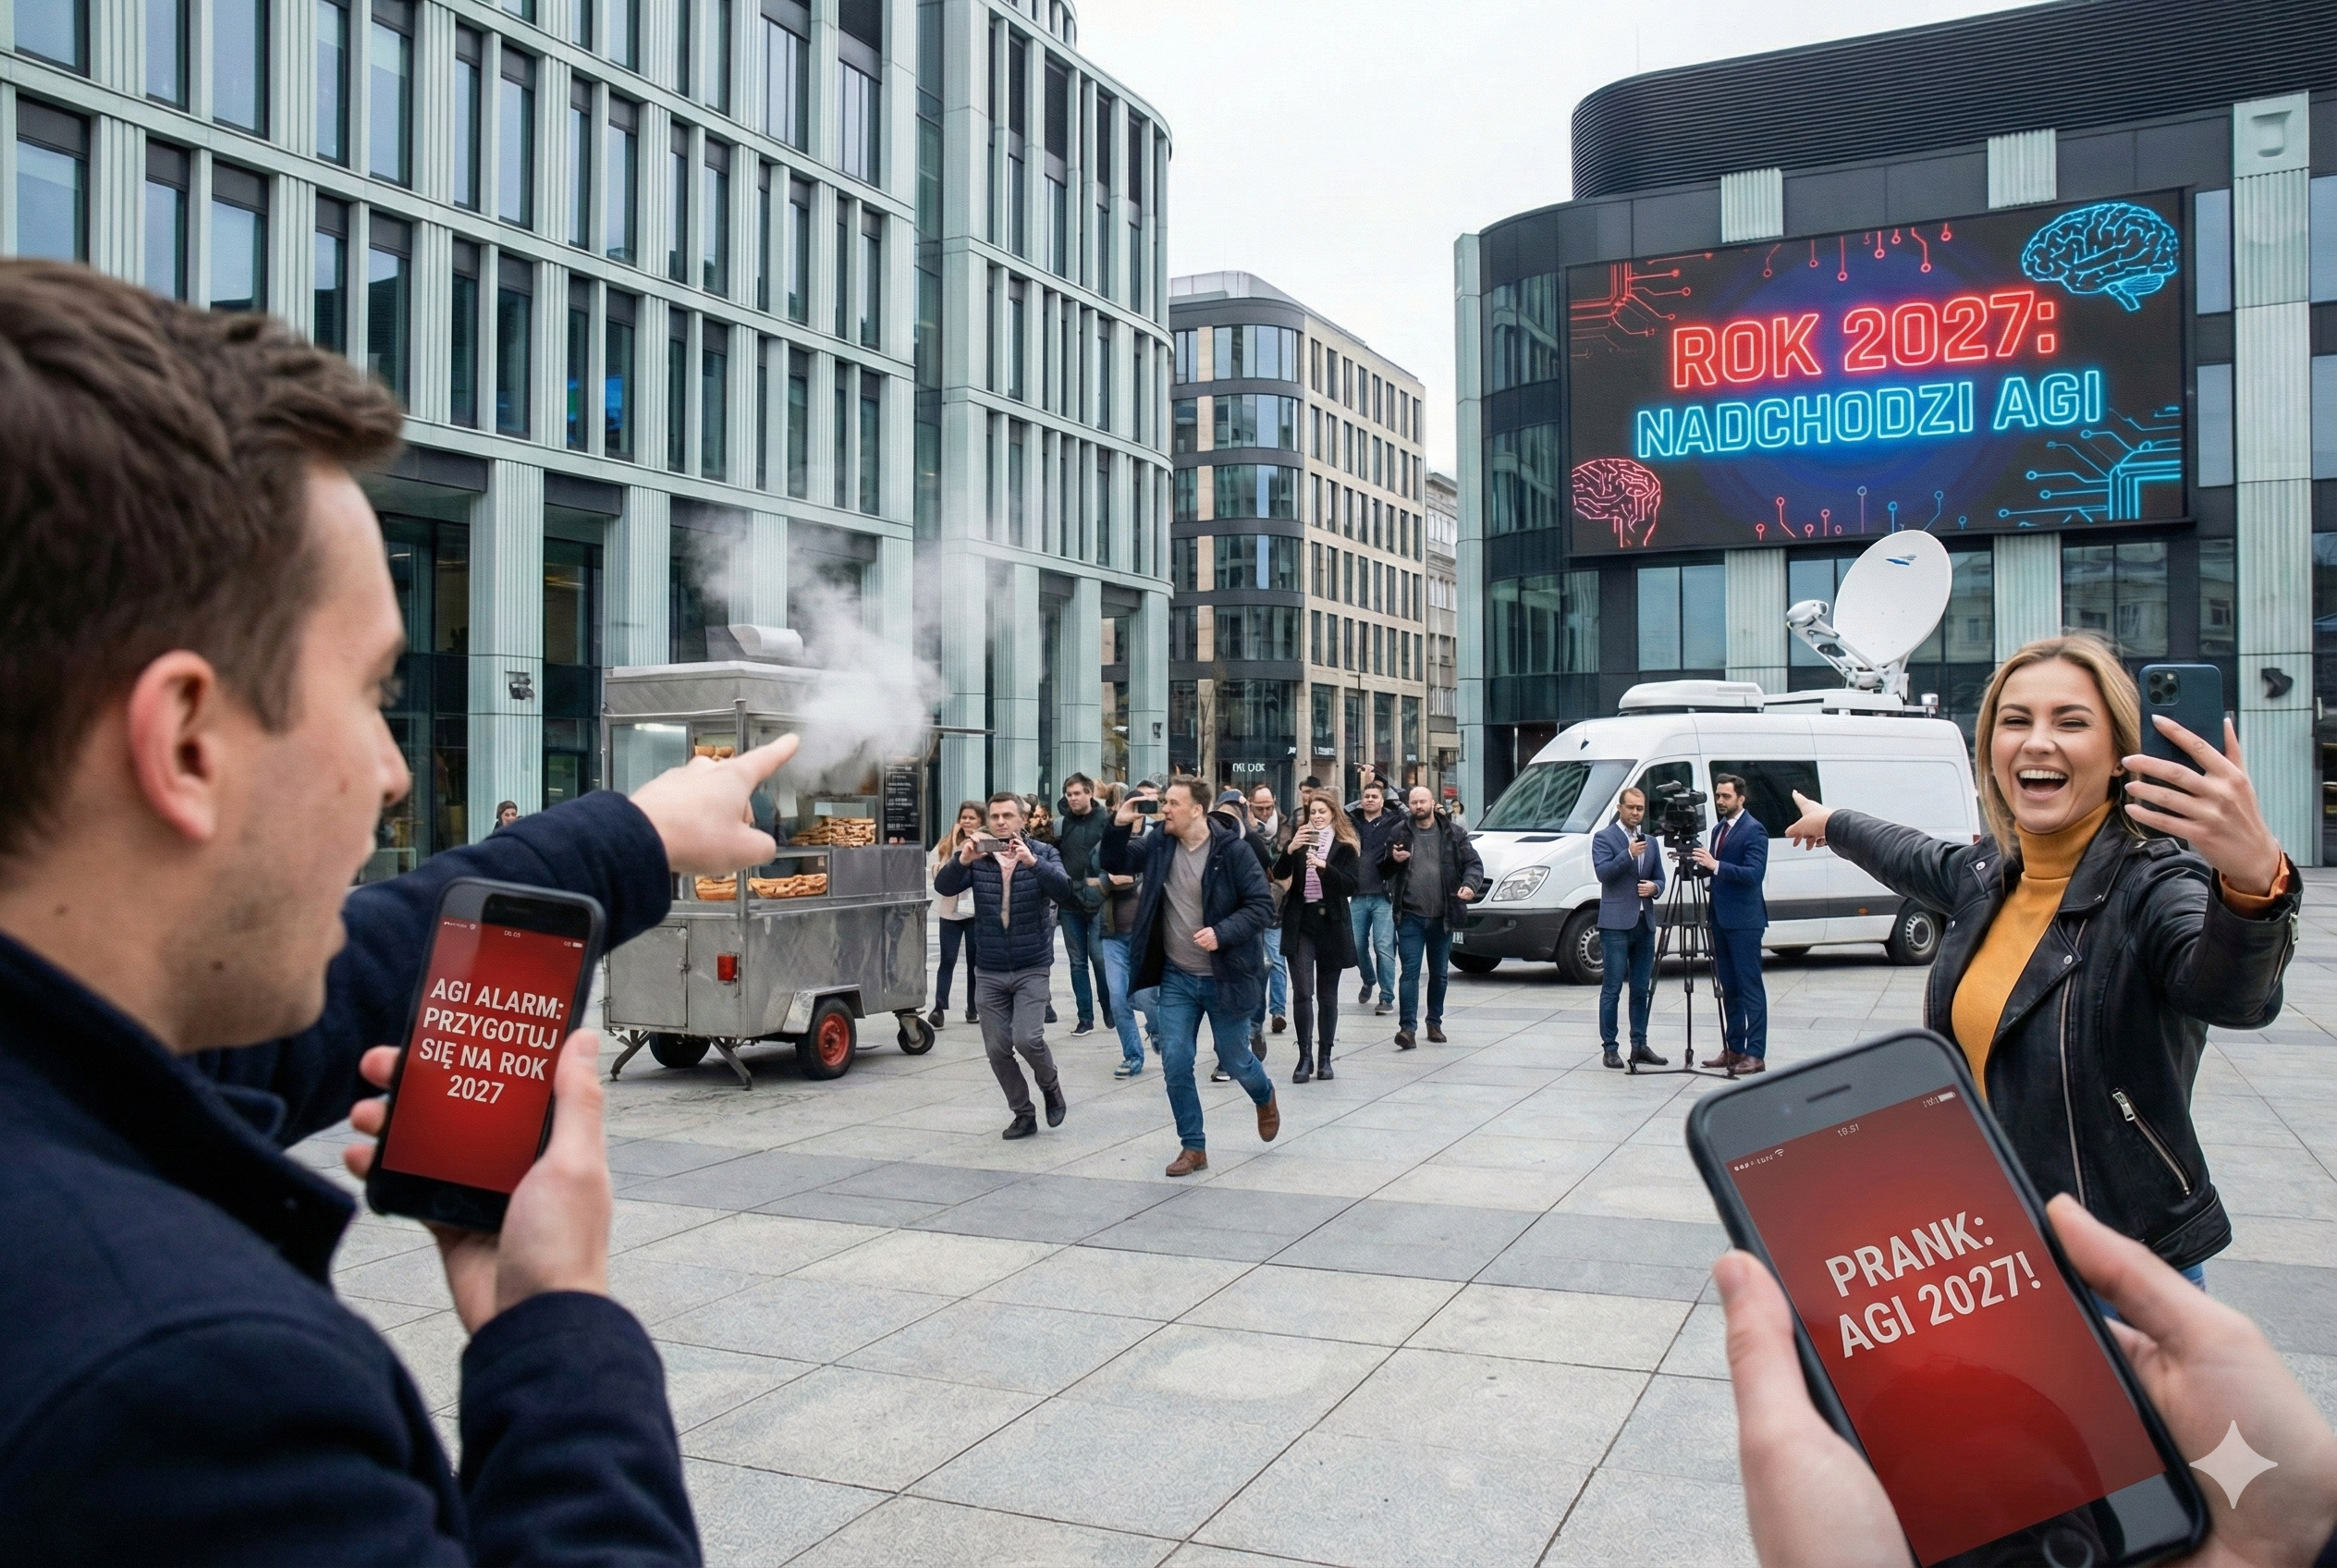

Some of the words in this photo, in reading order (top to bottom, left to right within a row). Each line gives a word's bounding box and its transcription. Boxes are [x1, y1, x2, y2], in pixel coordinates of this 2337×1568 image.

[1672, 312, 1822, 388] ROK
[1842, 289, 2056, 373] 2027:
[1636, 380, 1975, 459] NADCHODZI
[1992, 370, 2100, 431] AGI
[422, 1006, 558, 1050] PRZYGOTUJ
[430, 977, 471, 1004] AGI
[474, 986, 564, 1021] ALARM:
[419, 1037, 457, 1070] SIĘ
[459, 1045, 492, 1072] NA
[498, 1051, 548, 1081] ROK
[447, 1074, 505, 1104] 2027
[1825, 1210, 1995, 1298] PRANK:
[1839, 1295, 1916, 1358] AGI
[1917, 1250, 2042, 1327] 2027!
